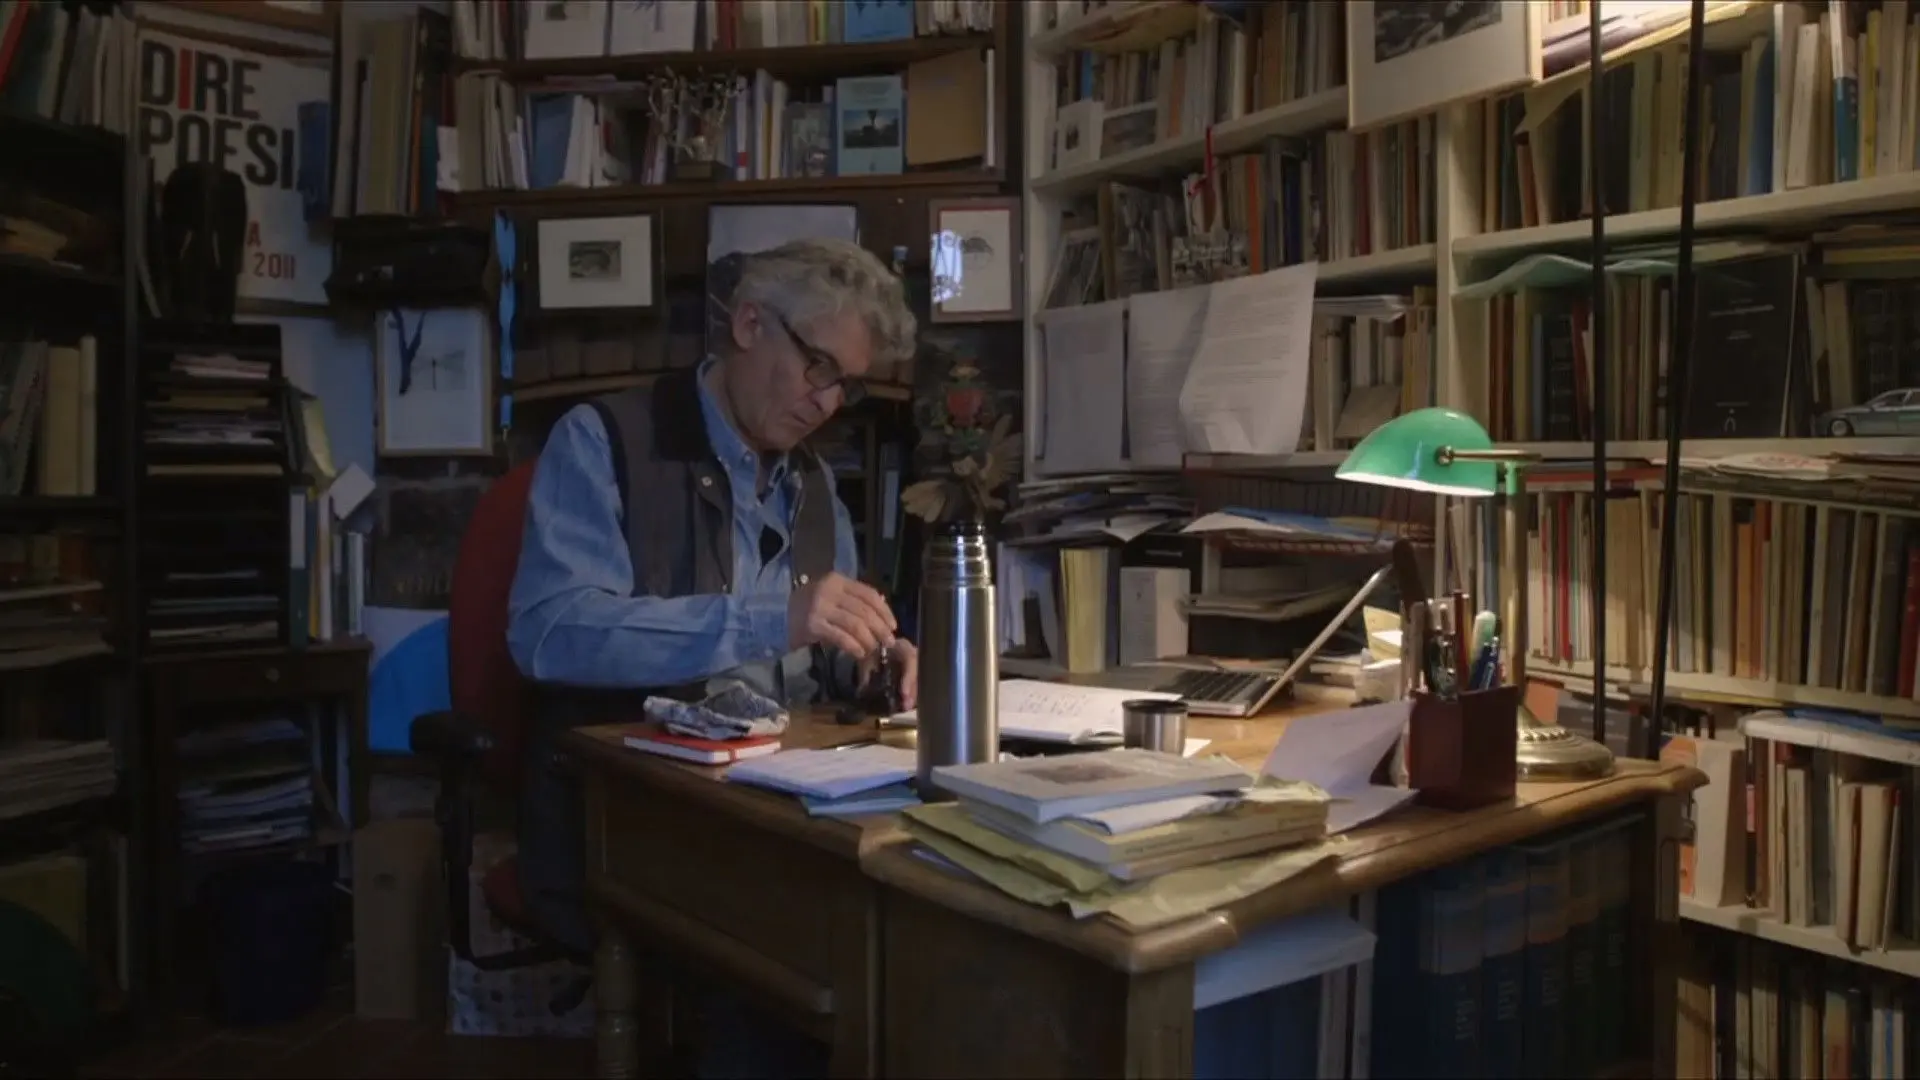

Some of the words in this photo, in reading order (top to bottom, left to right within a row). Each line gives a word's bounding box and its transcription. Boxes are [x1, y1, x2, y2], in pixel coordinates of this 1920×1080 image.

[140, 39, 261, 121] DIRE
[138, 106, 295, 190] POESI
[253, 252, 296, 280] 2011
